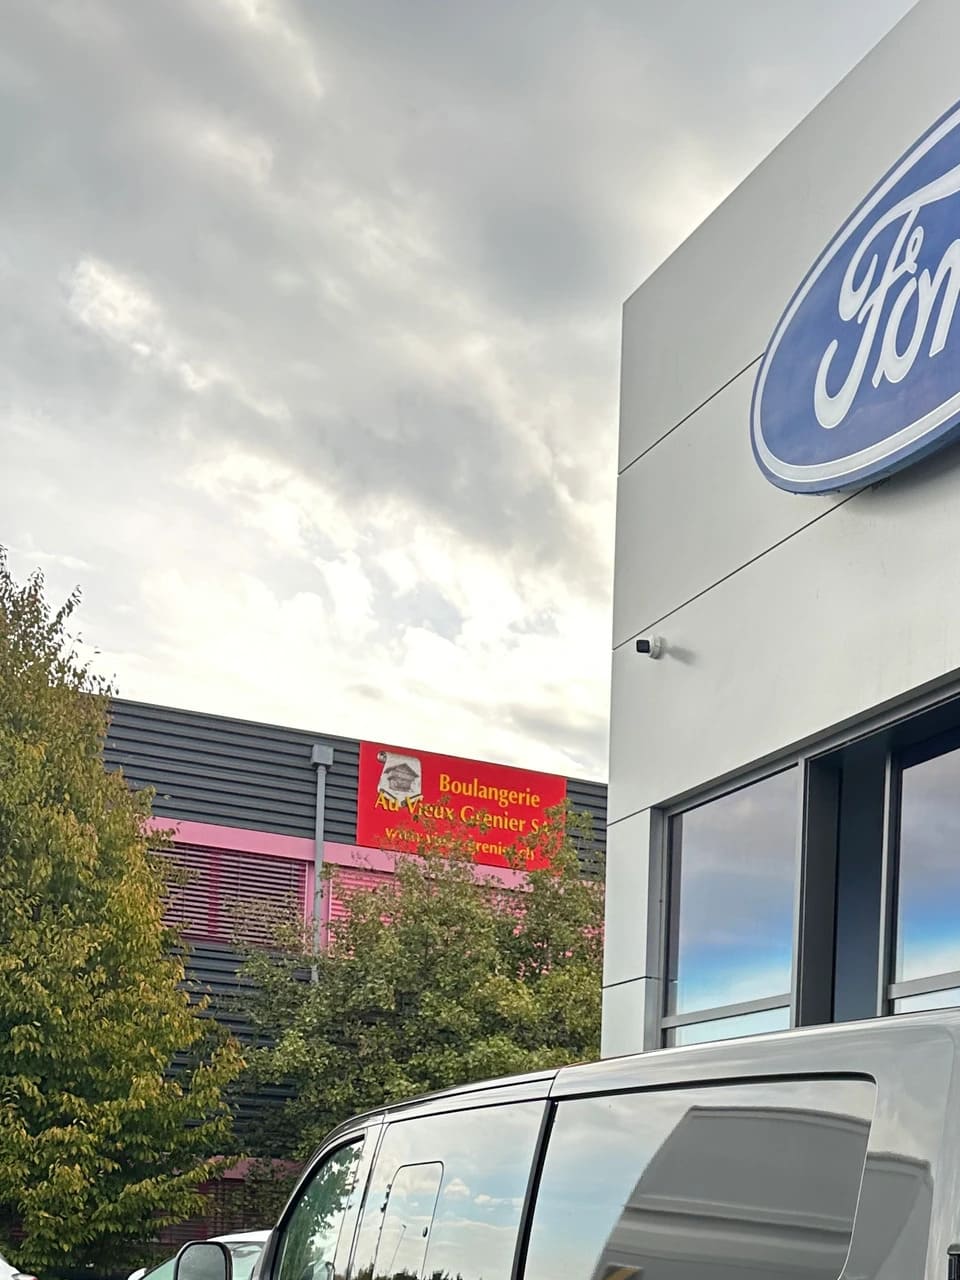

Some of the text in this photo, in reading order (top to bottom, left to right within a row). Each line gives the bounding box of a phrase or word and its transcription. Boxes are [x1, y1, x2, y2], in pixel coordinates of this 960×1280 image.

[375, 791, 399, 811] Au
[406, 796, 454, 820] Vieux
[439, 773, 541, 808] Boulangerie
